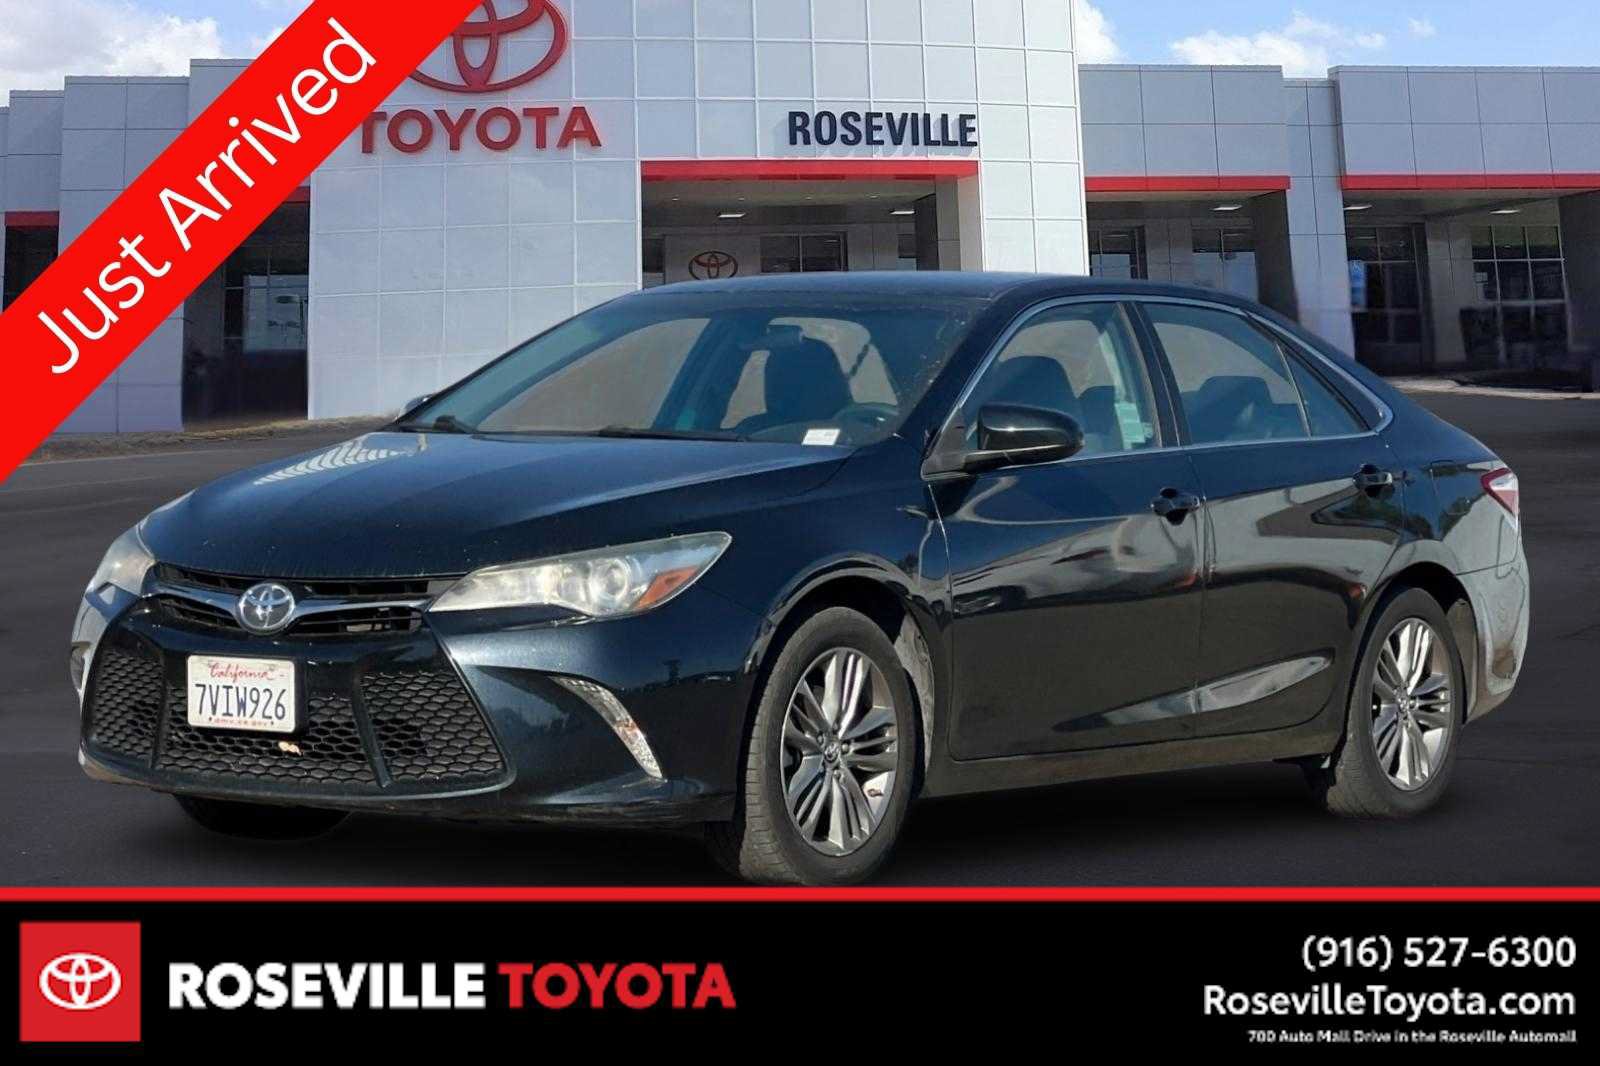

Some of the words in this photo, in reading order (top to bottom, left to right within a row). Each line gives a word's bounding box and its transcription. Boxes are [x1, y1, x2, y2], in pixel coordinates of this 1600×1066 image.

[361, 106, 602, 154] TOYOTA
[788, 110, 979, 147] ROSEVILLE
[209, 662, 273, 682] California
[194, 683, 287, 720] 7VIW926
